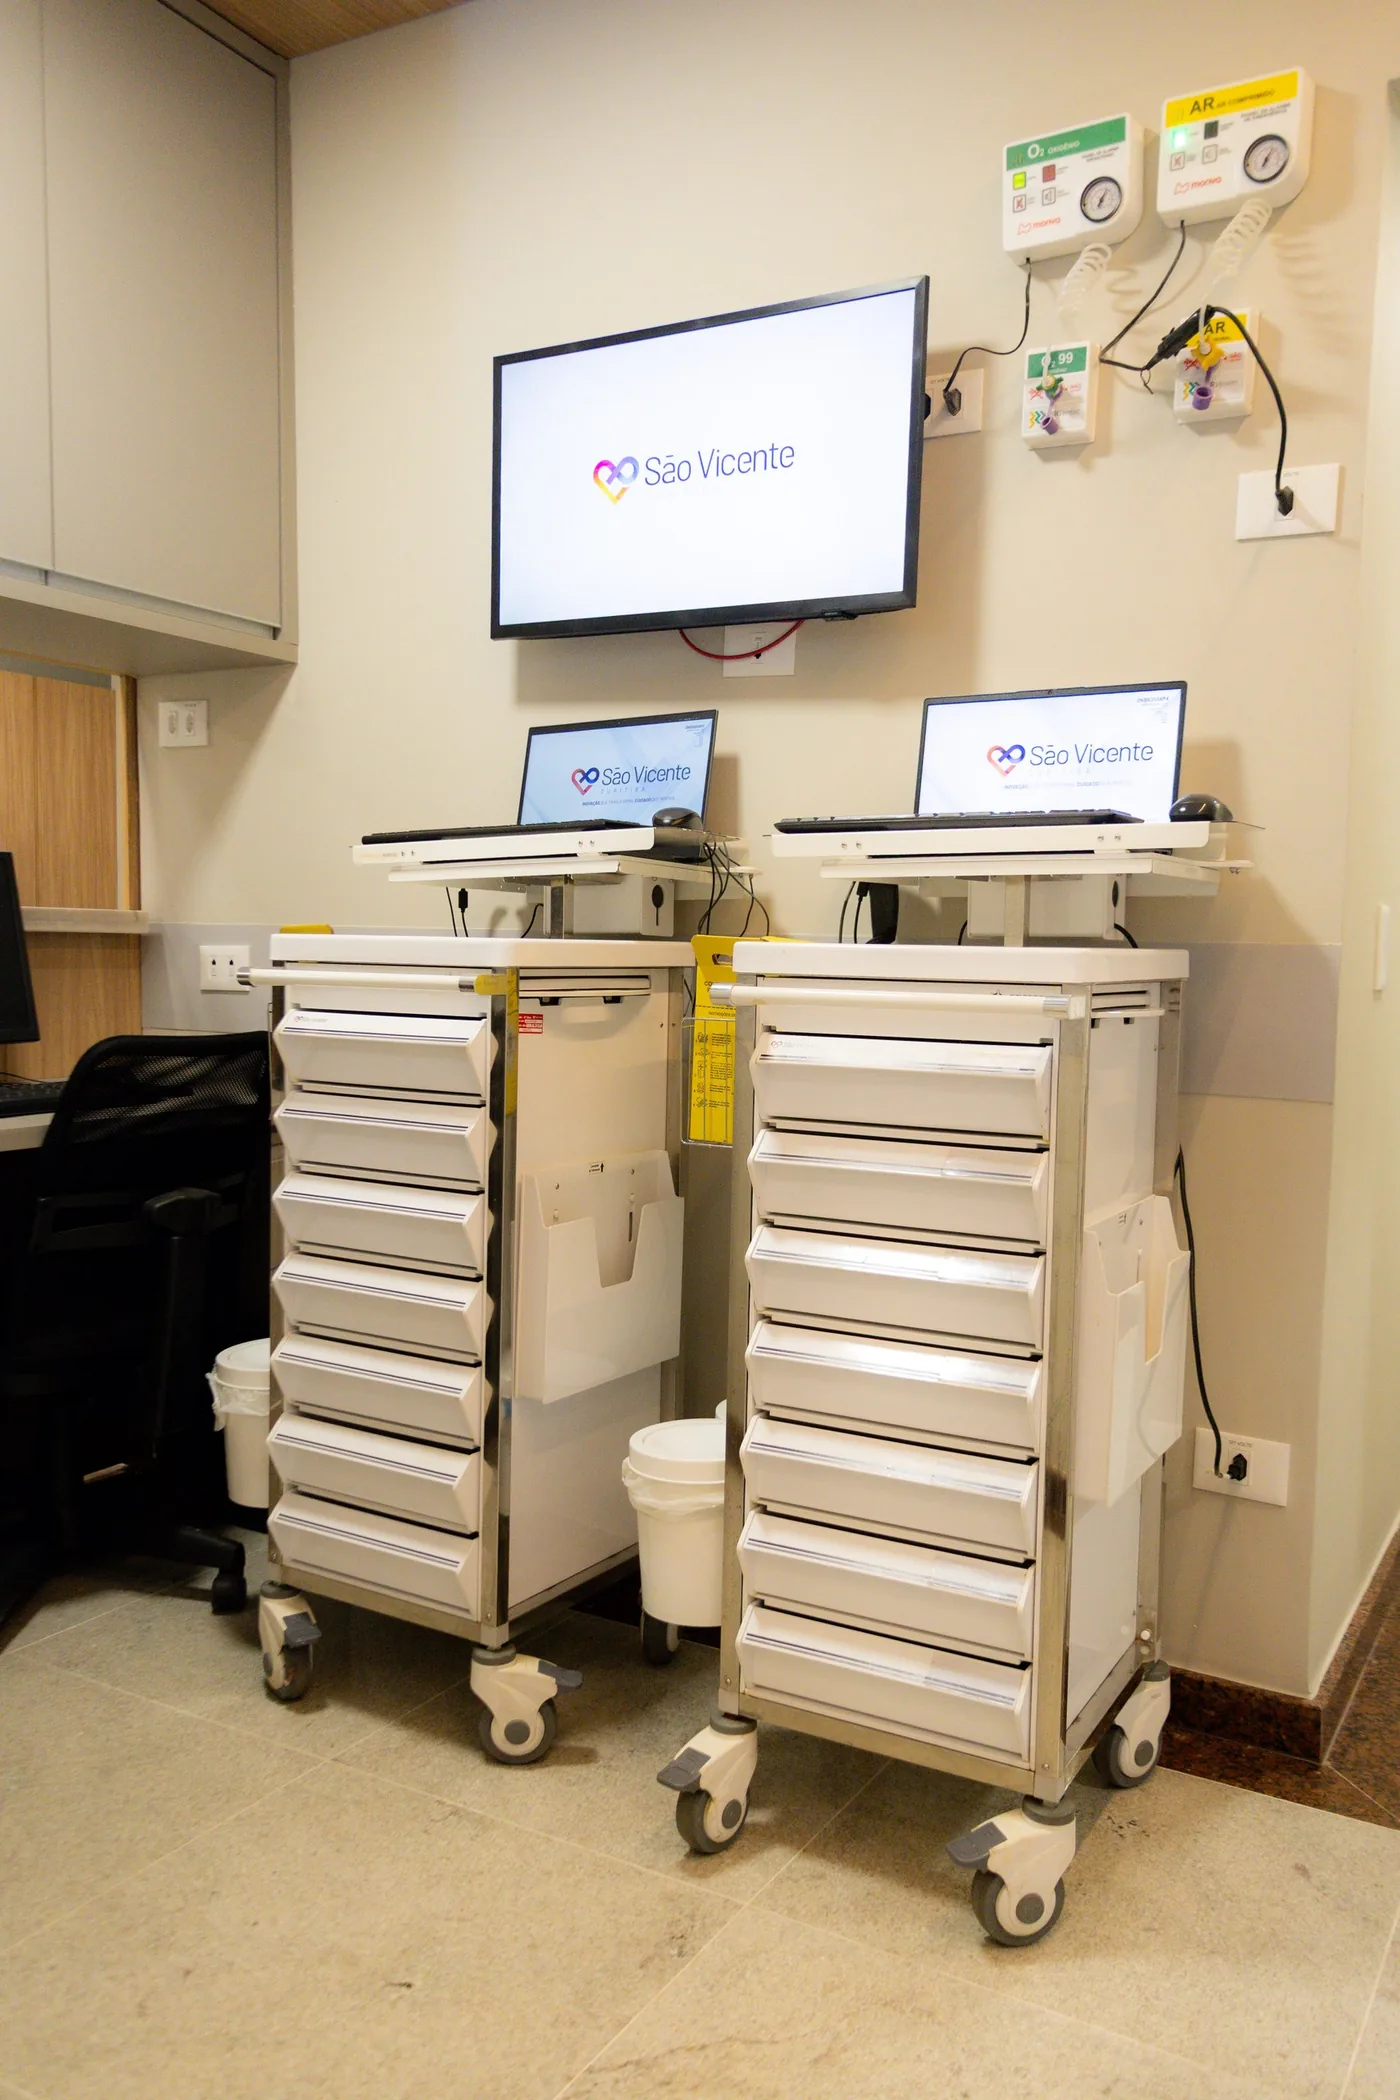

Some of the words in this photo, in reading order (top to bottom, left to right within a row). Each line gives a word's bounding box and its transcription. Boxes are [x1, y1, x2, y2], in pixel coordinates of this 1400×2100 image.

[1189, 97, 1215, 116] AR
[1204, 321, 1226, 335] AR
[1058, 352, 1073, 365] 99
[645, 455, 692, 486] São
[697, 443, 795, 479] Vicente
[1030, 744, 1069, 766] São
[1074, 743, 1154, 764] Vicente
[601, 767, 631, 786] São
[634, 764, 691, 783] Vicente
